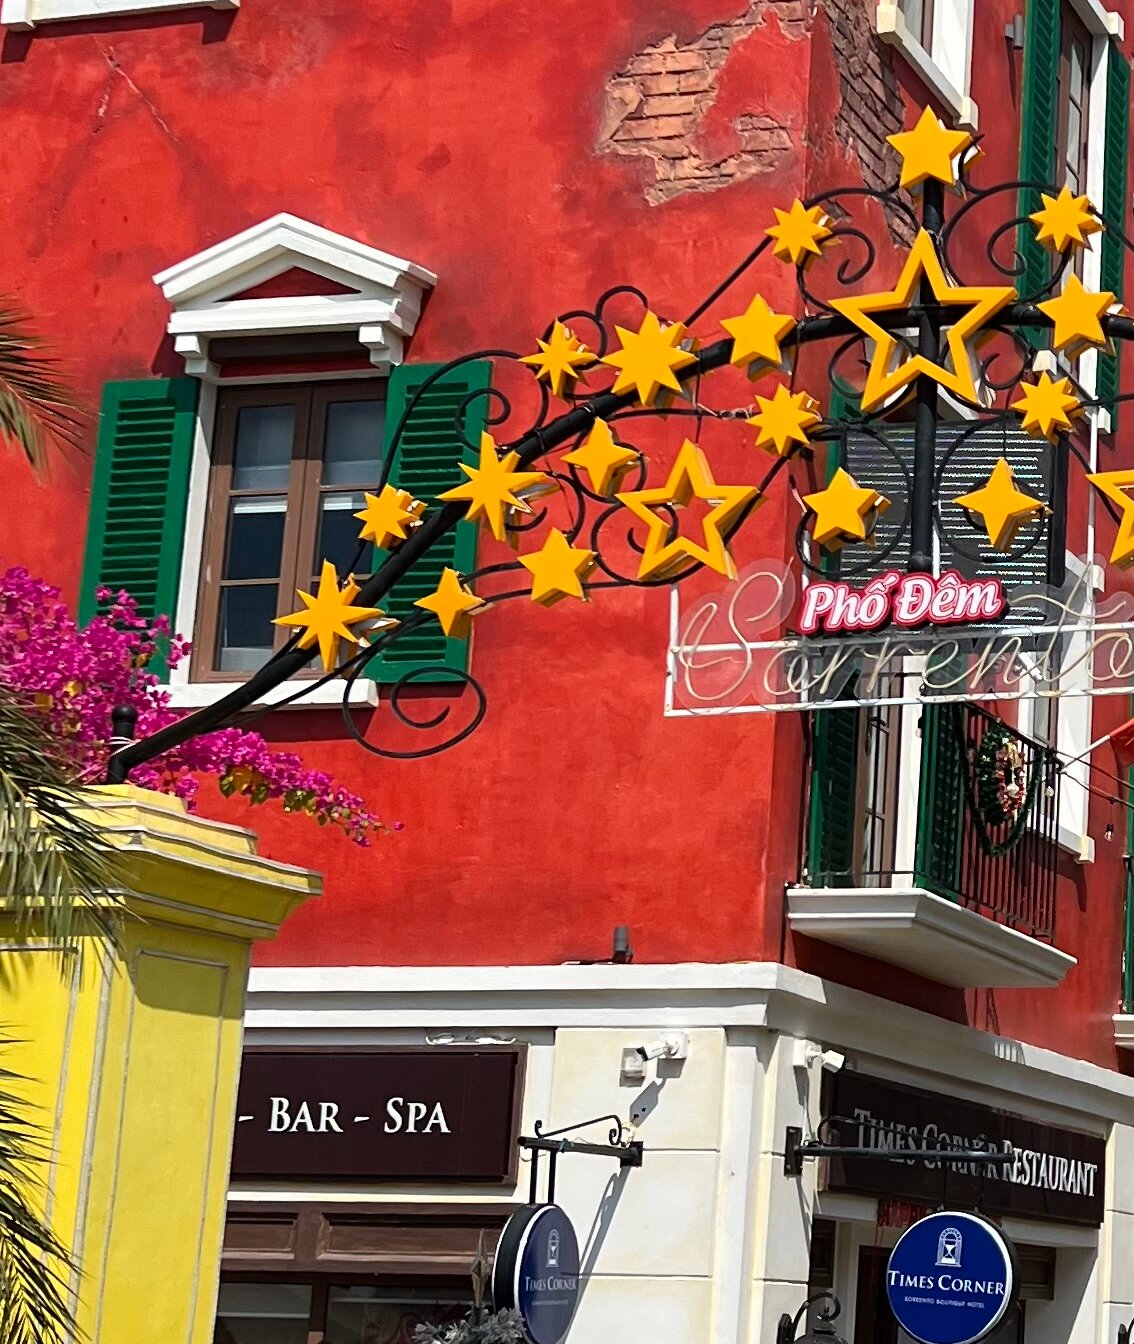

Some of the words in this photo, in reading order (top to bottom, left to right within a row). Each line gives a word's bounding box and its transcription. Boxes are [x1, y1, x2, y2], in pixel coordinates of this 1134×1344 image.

[802, 574, 898, 630] Phố
[897, 573, 1001, 621] Đêm
[268, 1097, 344, 1133] BAR
[384, 1097, 452, 1133] SPA
[854, 1108, 919, 1165] TIMES
[1002, 1139, 1098, 1197] RESTAURANT
[525, 1276, 546, 1291] TIMES
[547, 1276, 577, 1291] CORNER
[887, 1269, 934, 1289] TIMES
[938, 1275, 1005, 1295] CORNER
